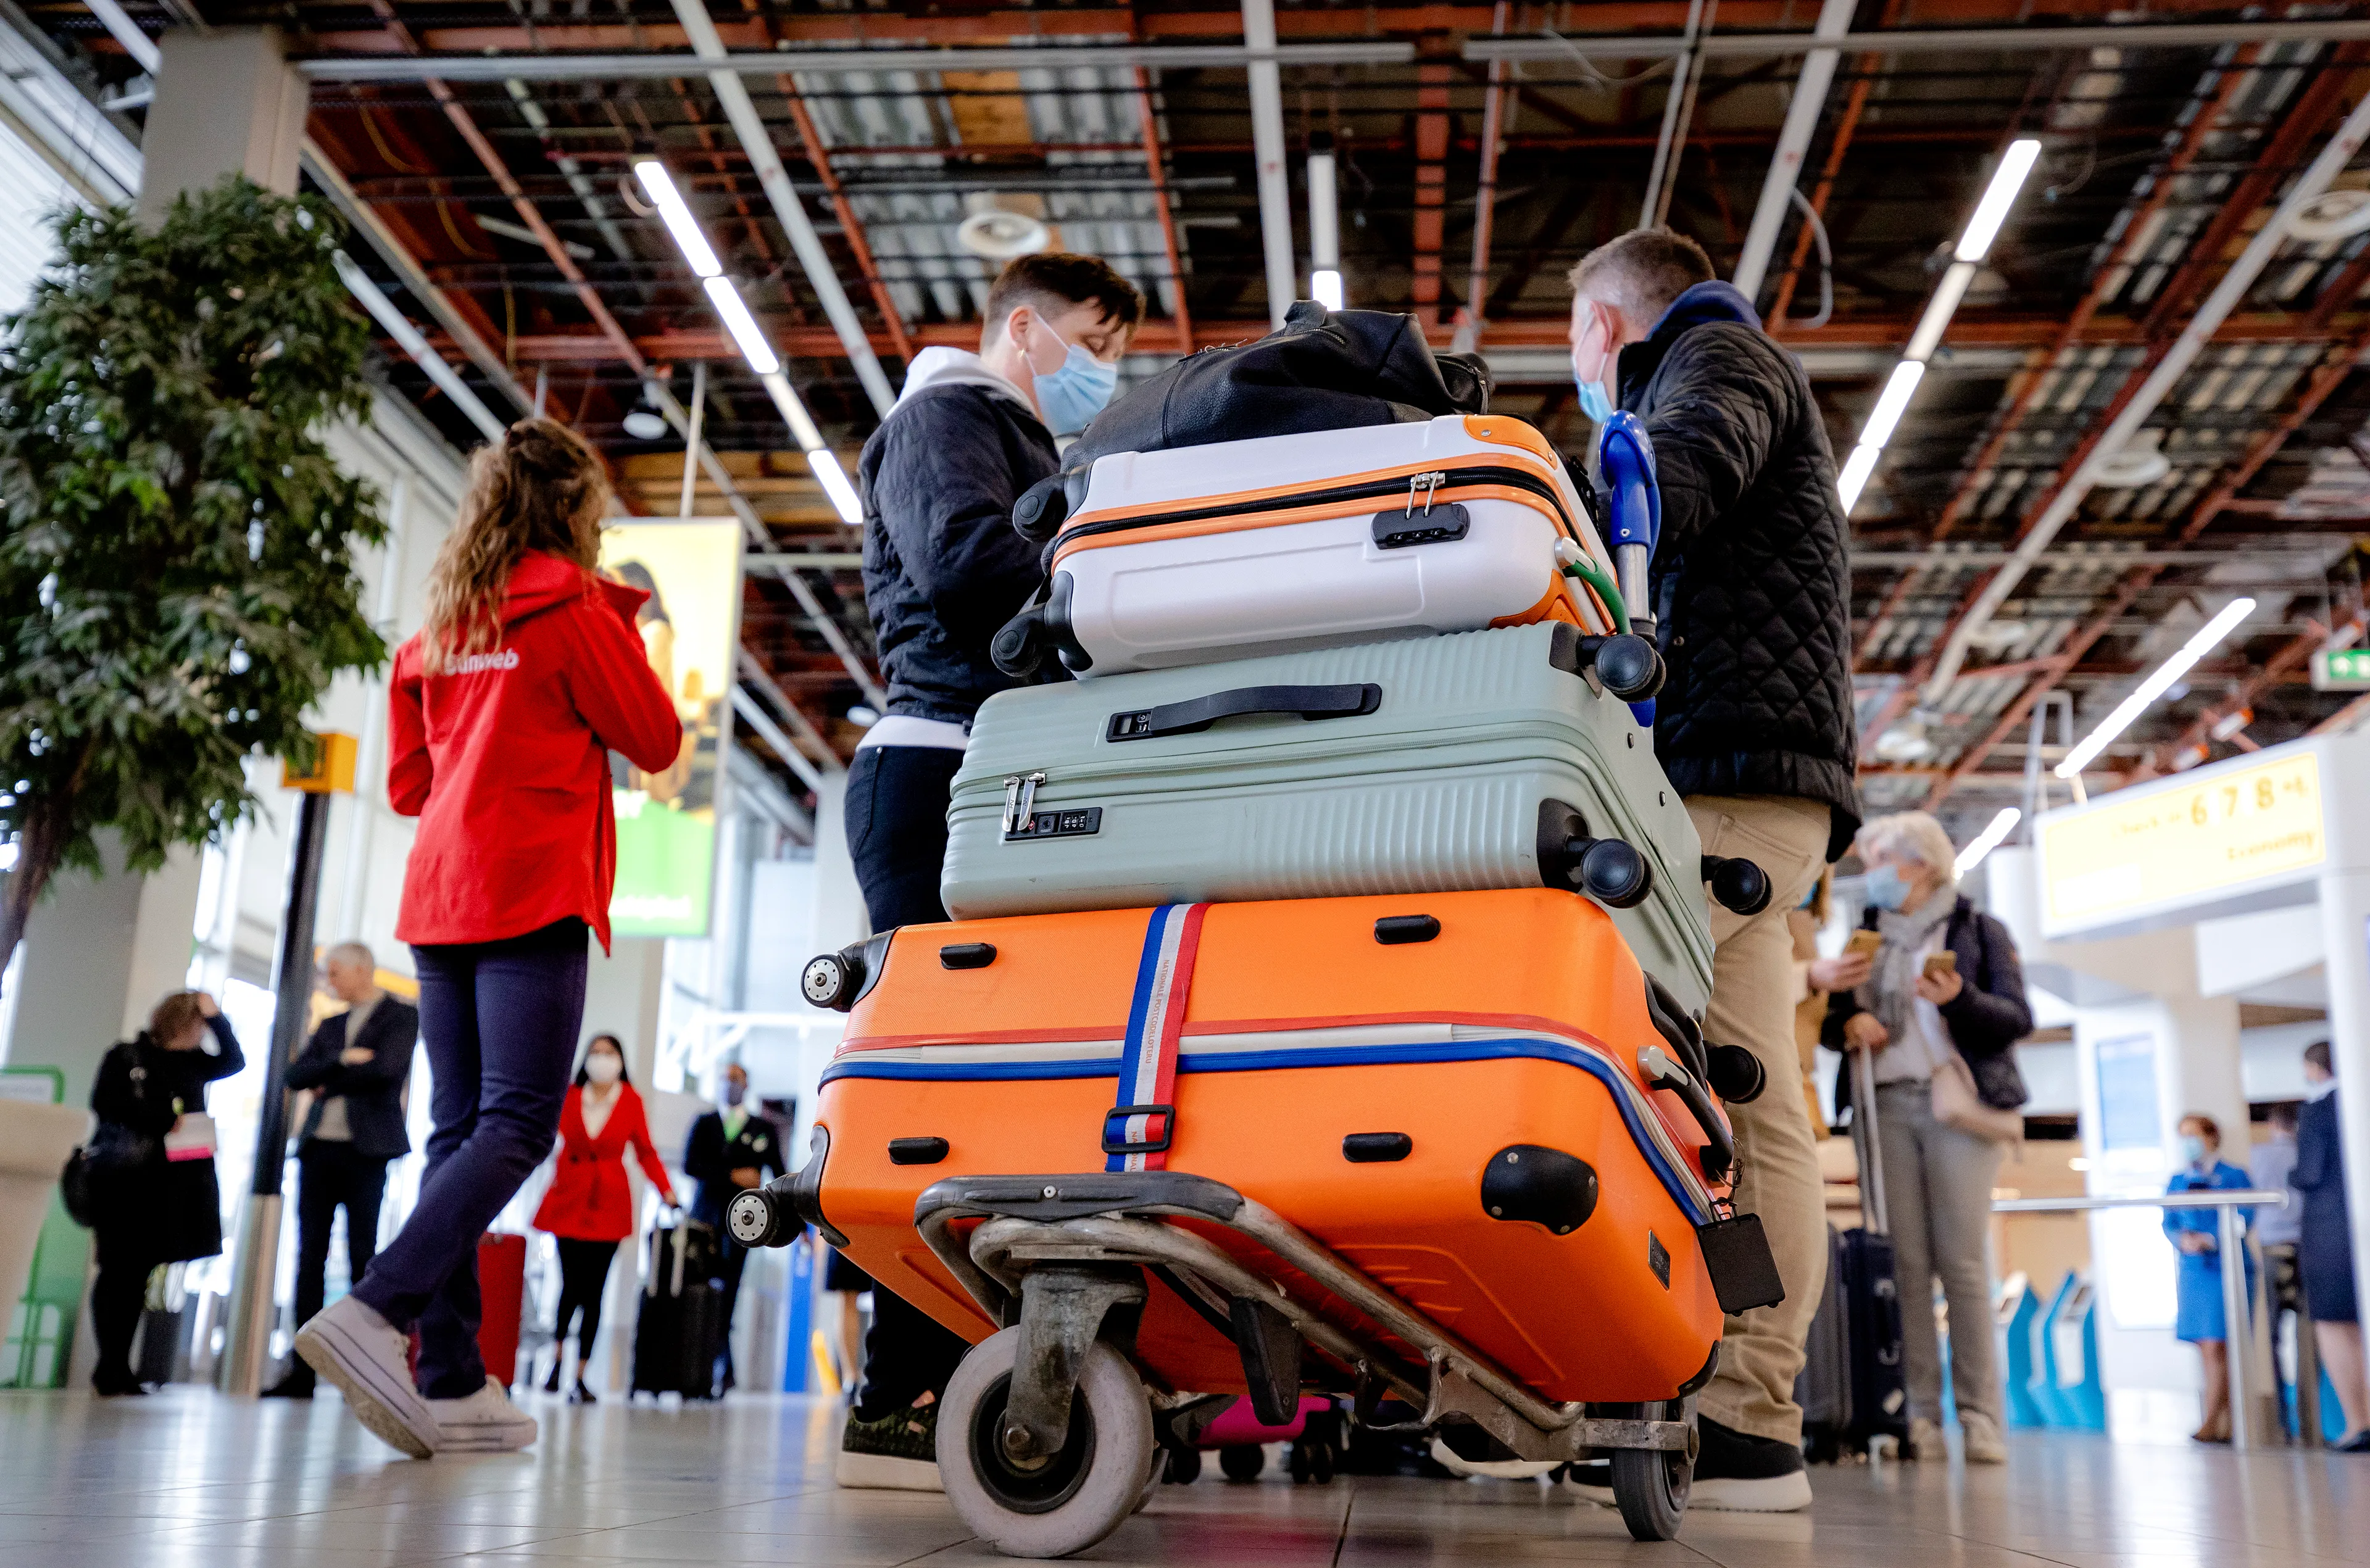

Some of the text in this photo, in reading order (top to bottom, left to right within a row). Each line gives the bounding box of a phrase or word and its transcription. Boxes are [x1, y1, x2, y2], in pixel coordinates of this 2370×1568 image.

[2190, 794, 2208, 828] 6
[2222, 786, 2239, 818] 7
[2255, 776, 2275, 810] 8
[1158, 960, 1170, 997] NATIONALE
